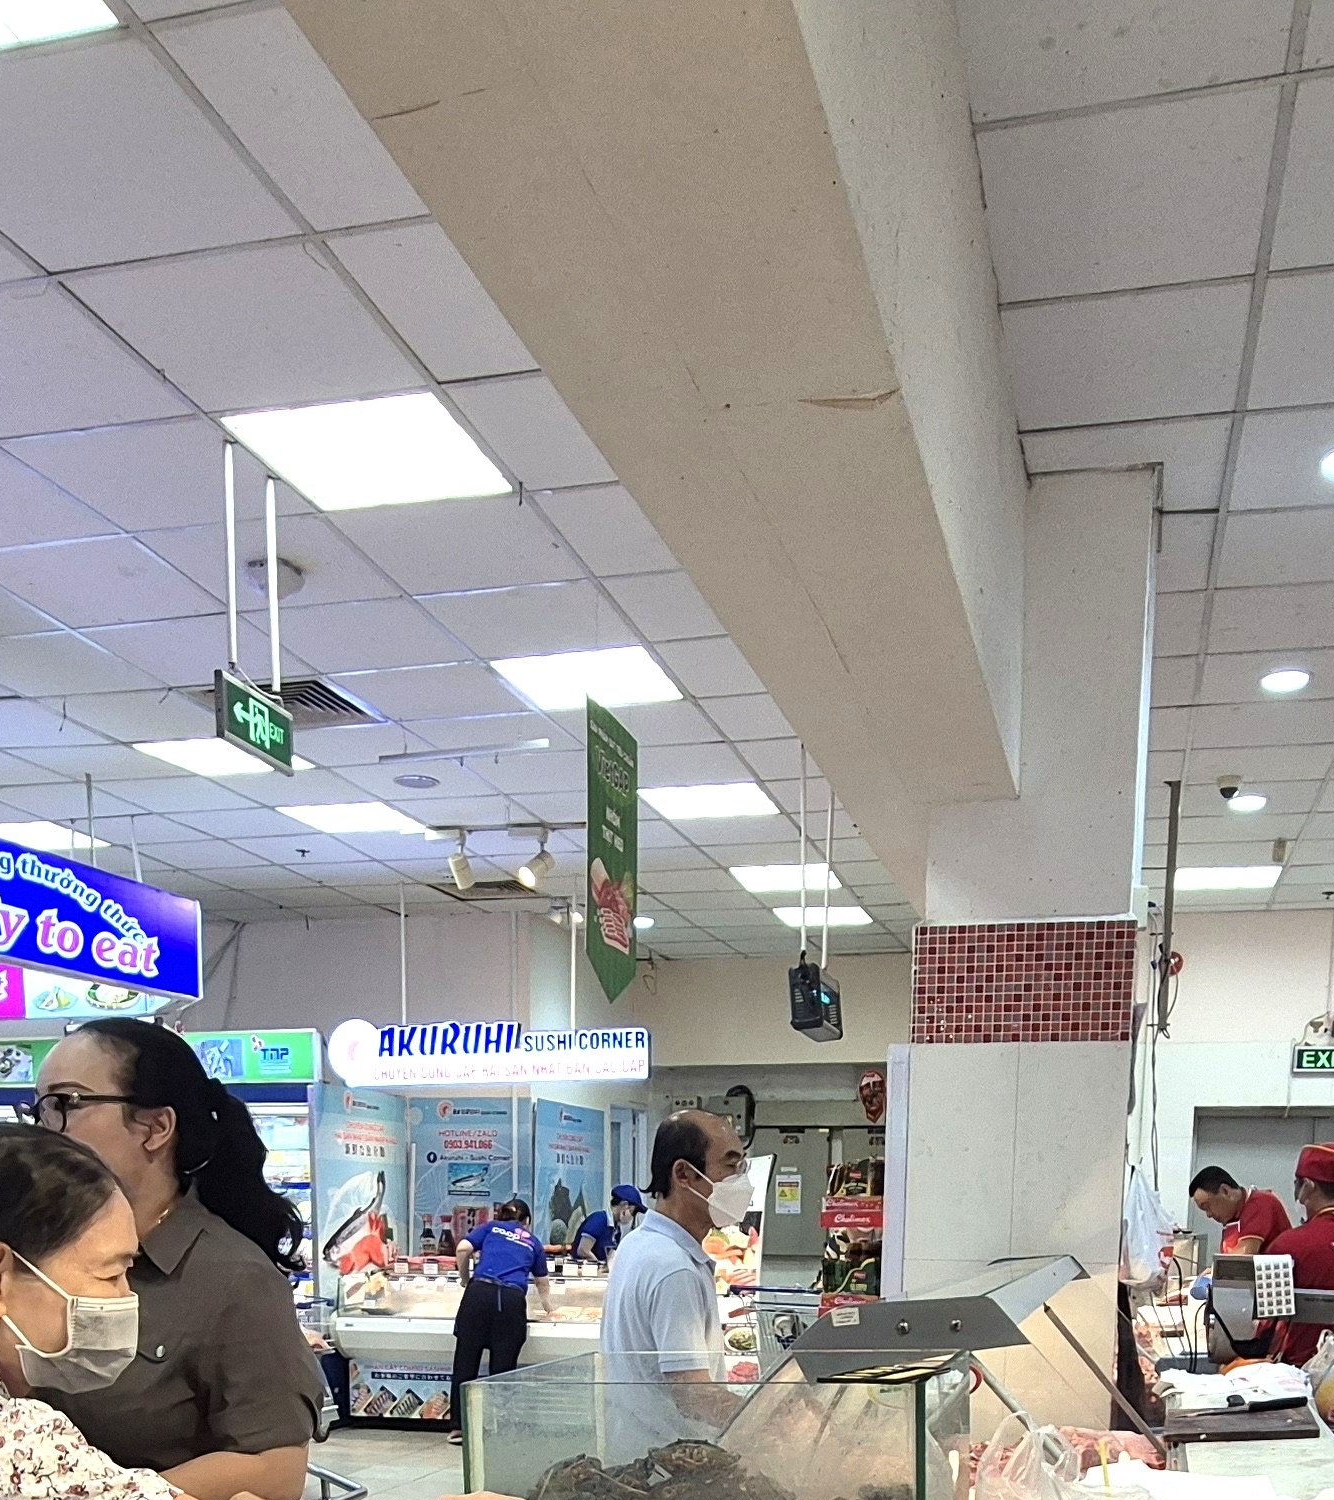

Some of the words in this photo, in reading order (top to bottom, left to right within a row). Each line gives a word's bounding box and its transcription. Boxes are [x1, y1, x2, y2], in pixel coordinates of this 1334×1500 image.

[21, 857, 98, 907] thưởng
[103, 904, 146, 944] thức
[41, 915, 81, 953] to
[96, 936, 158, 971] eat
[379, 1023, 515, 1057] AKURUHI
[524, 1033, 573, 1052] SUSHI
[579, 1031, 645, 1049] CORNER
[834, 1213, 871, 1223] Cholimex
